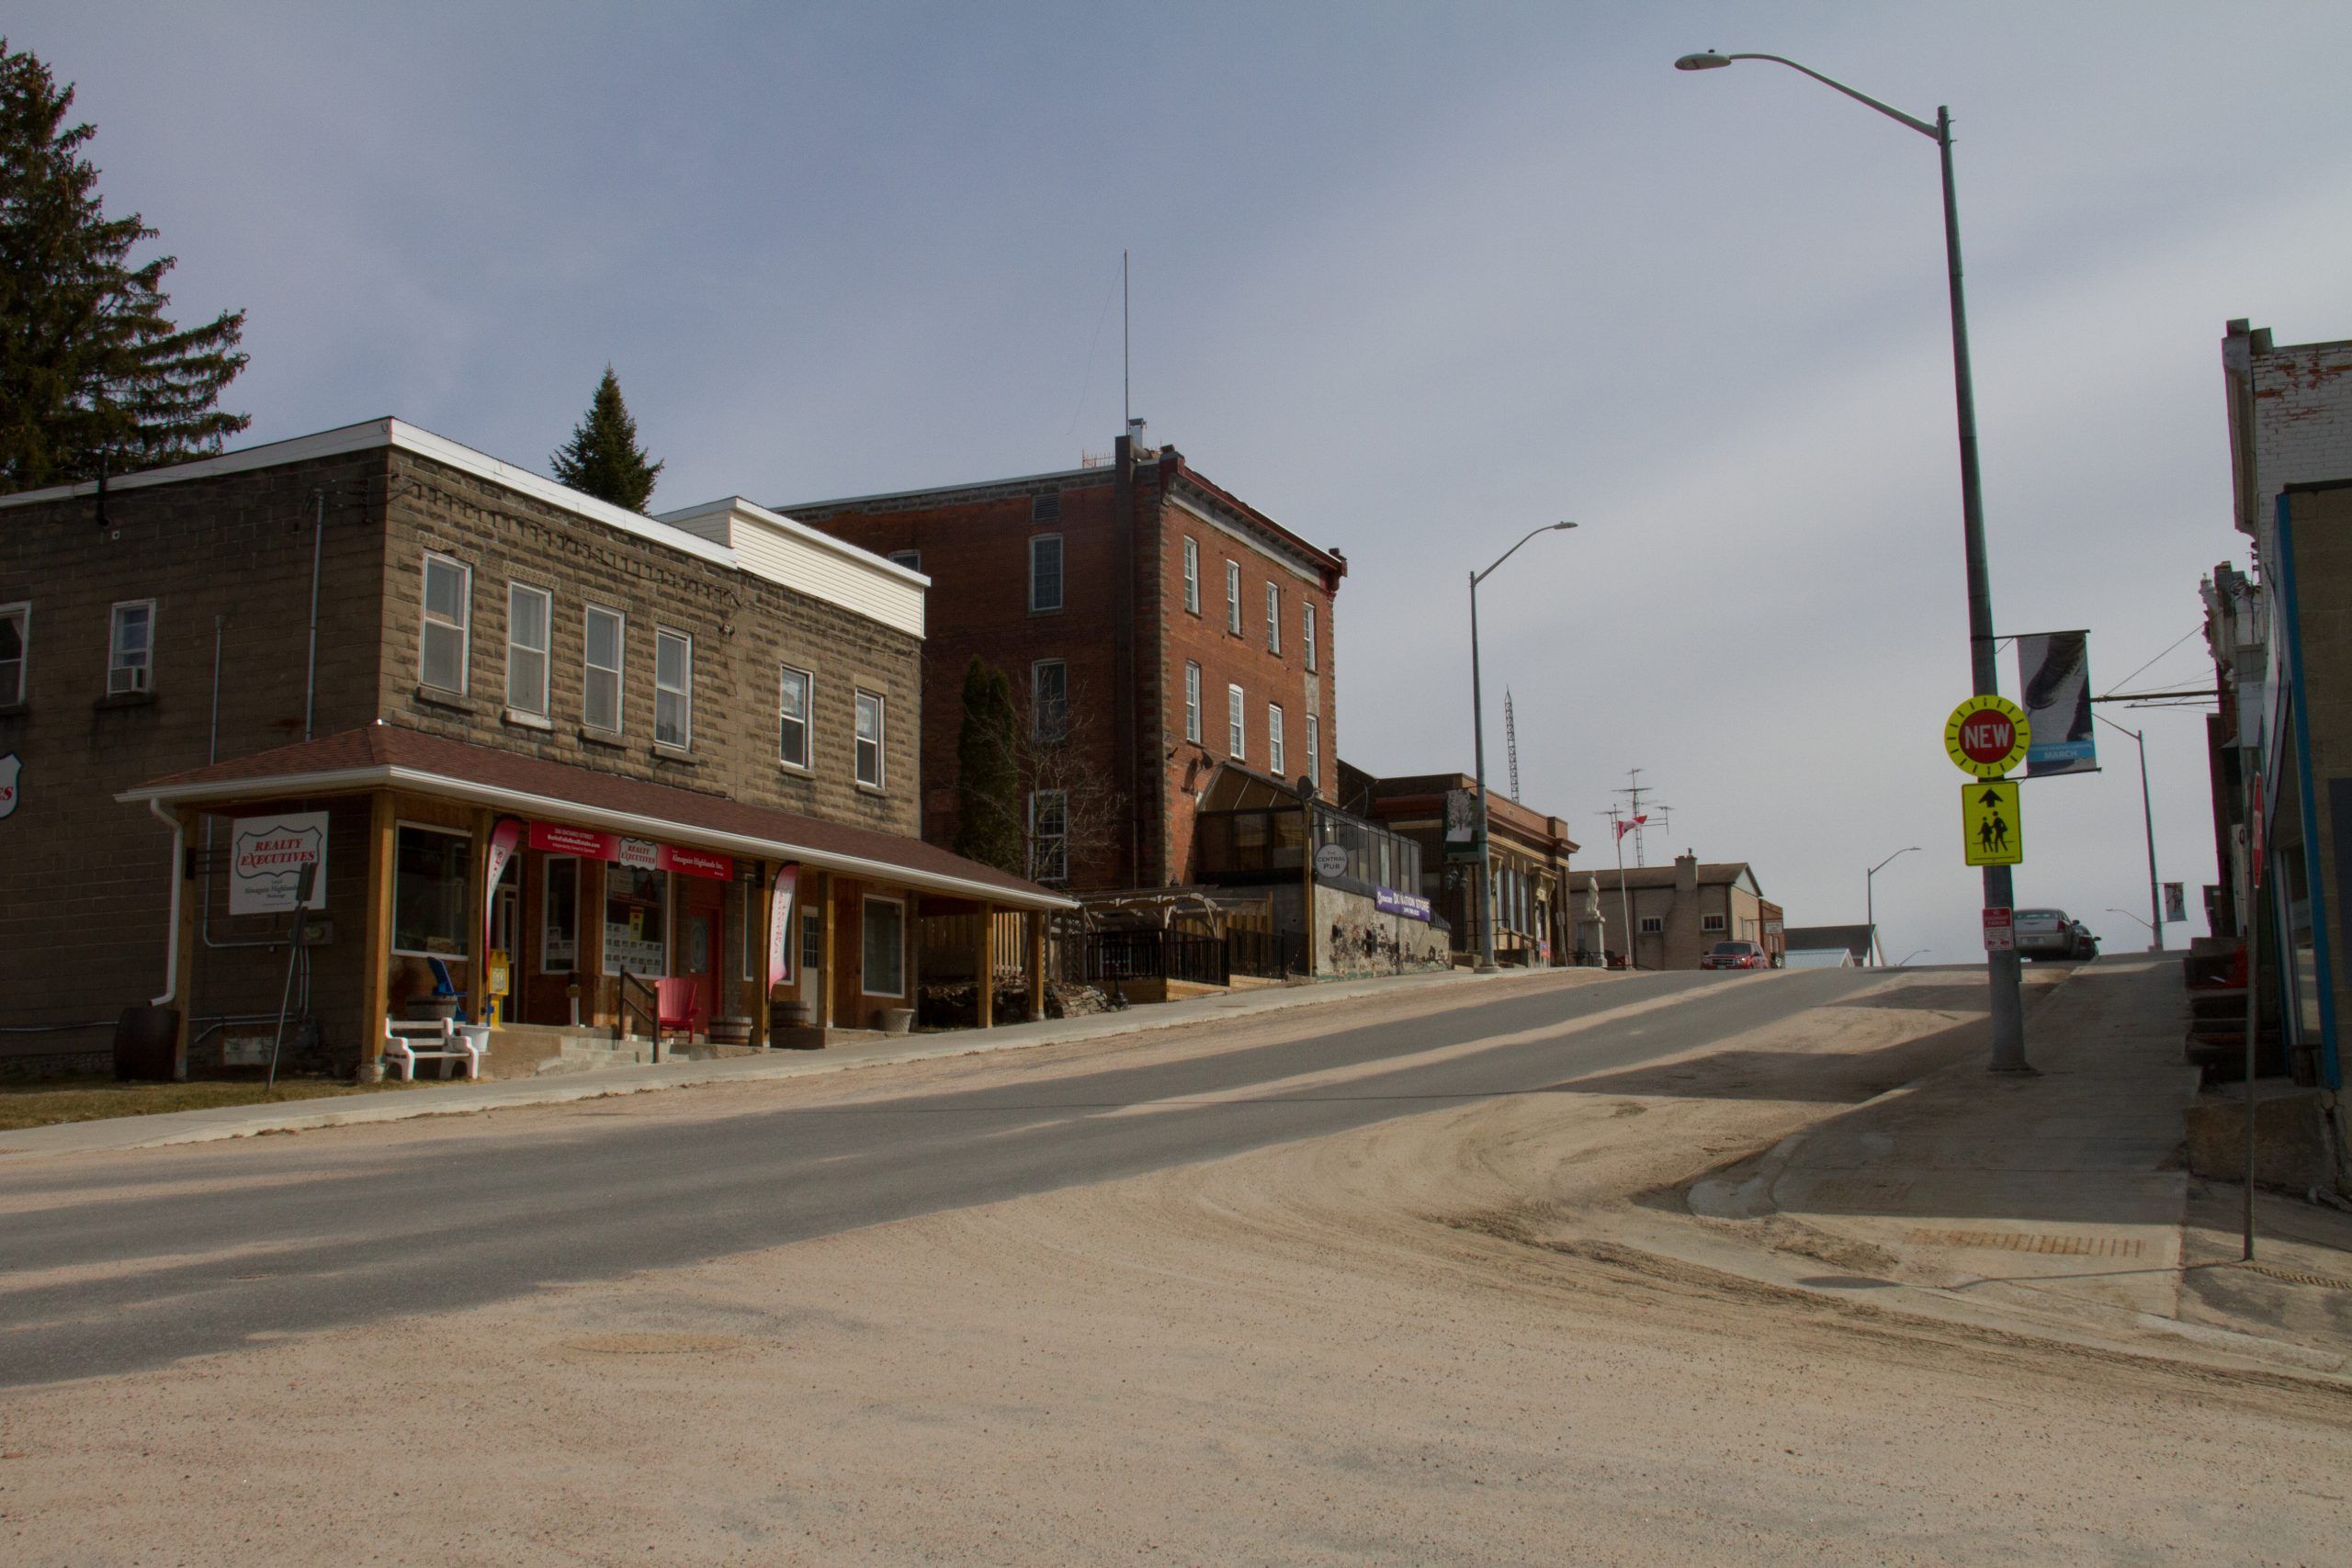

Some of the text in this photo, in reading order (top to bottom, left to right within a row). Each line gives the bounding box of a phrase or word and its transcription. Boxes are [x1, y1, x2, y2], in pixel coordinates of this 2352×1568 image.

[1964, 723, 2010, 750] NEW
[2043, 750, 2077, 759] MARCH
[254, 838, 302, 852] REALTY
[628, 845, 650, 854] REALTY
[241, 851, 315, 868] EXECUTIVES
[621, 852, 655, 864] EXECUTIVES
[271, 885, 298, 894] Highland
